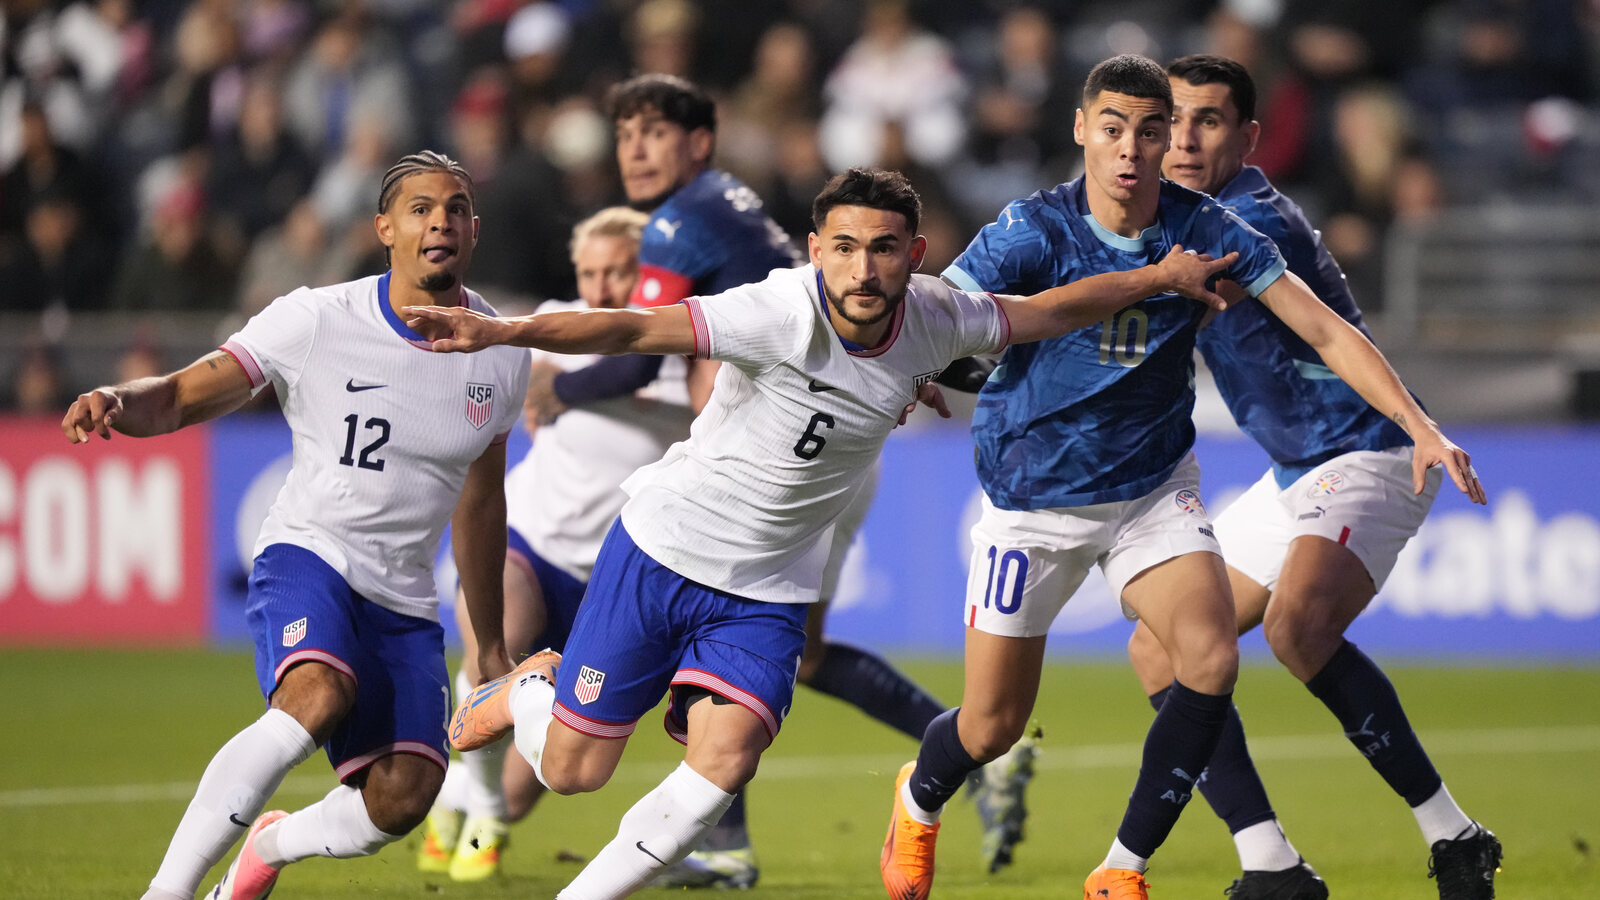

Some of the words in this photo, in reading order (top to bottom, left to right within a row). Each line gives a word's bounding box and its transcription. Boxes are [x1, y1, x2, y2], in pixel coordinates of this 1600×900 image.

[1099, 309, 1148, 367] 10
[468, 385, 492, 404] USA
[339, 413, 391, 472] 12
[793, 412, 835, 461] 6
[0, 454, 184, 603] OM
[984, 545, 1029, 615] 10
[285, 619, 305, 634] USA
[581, 667, 603, 684] USA
